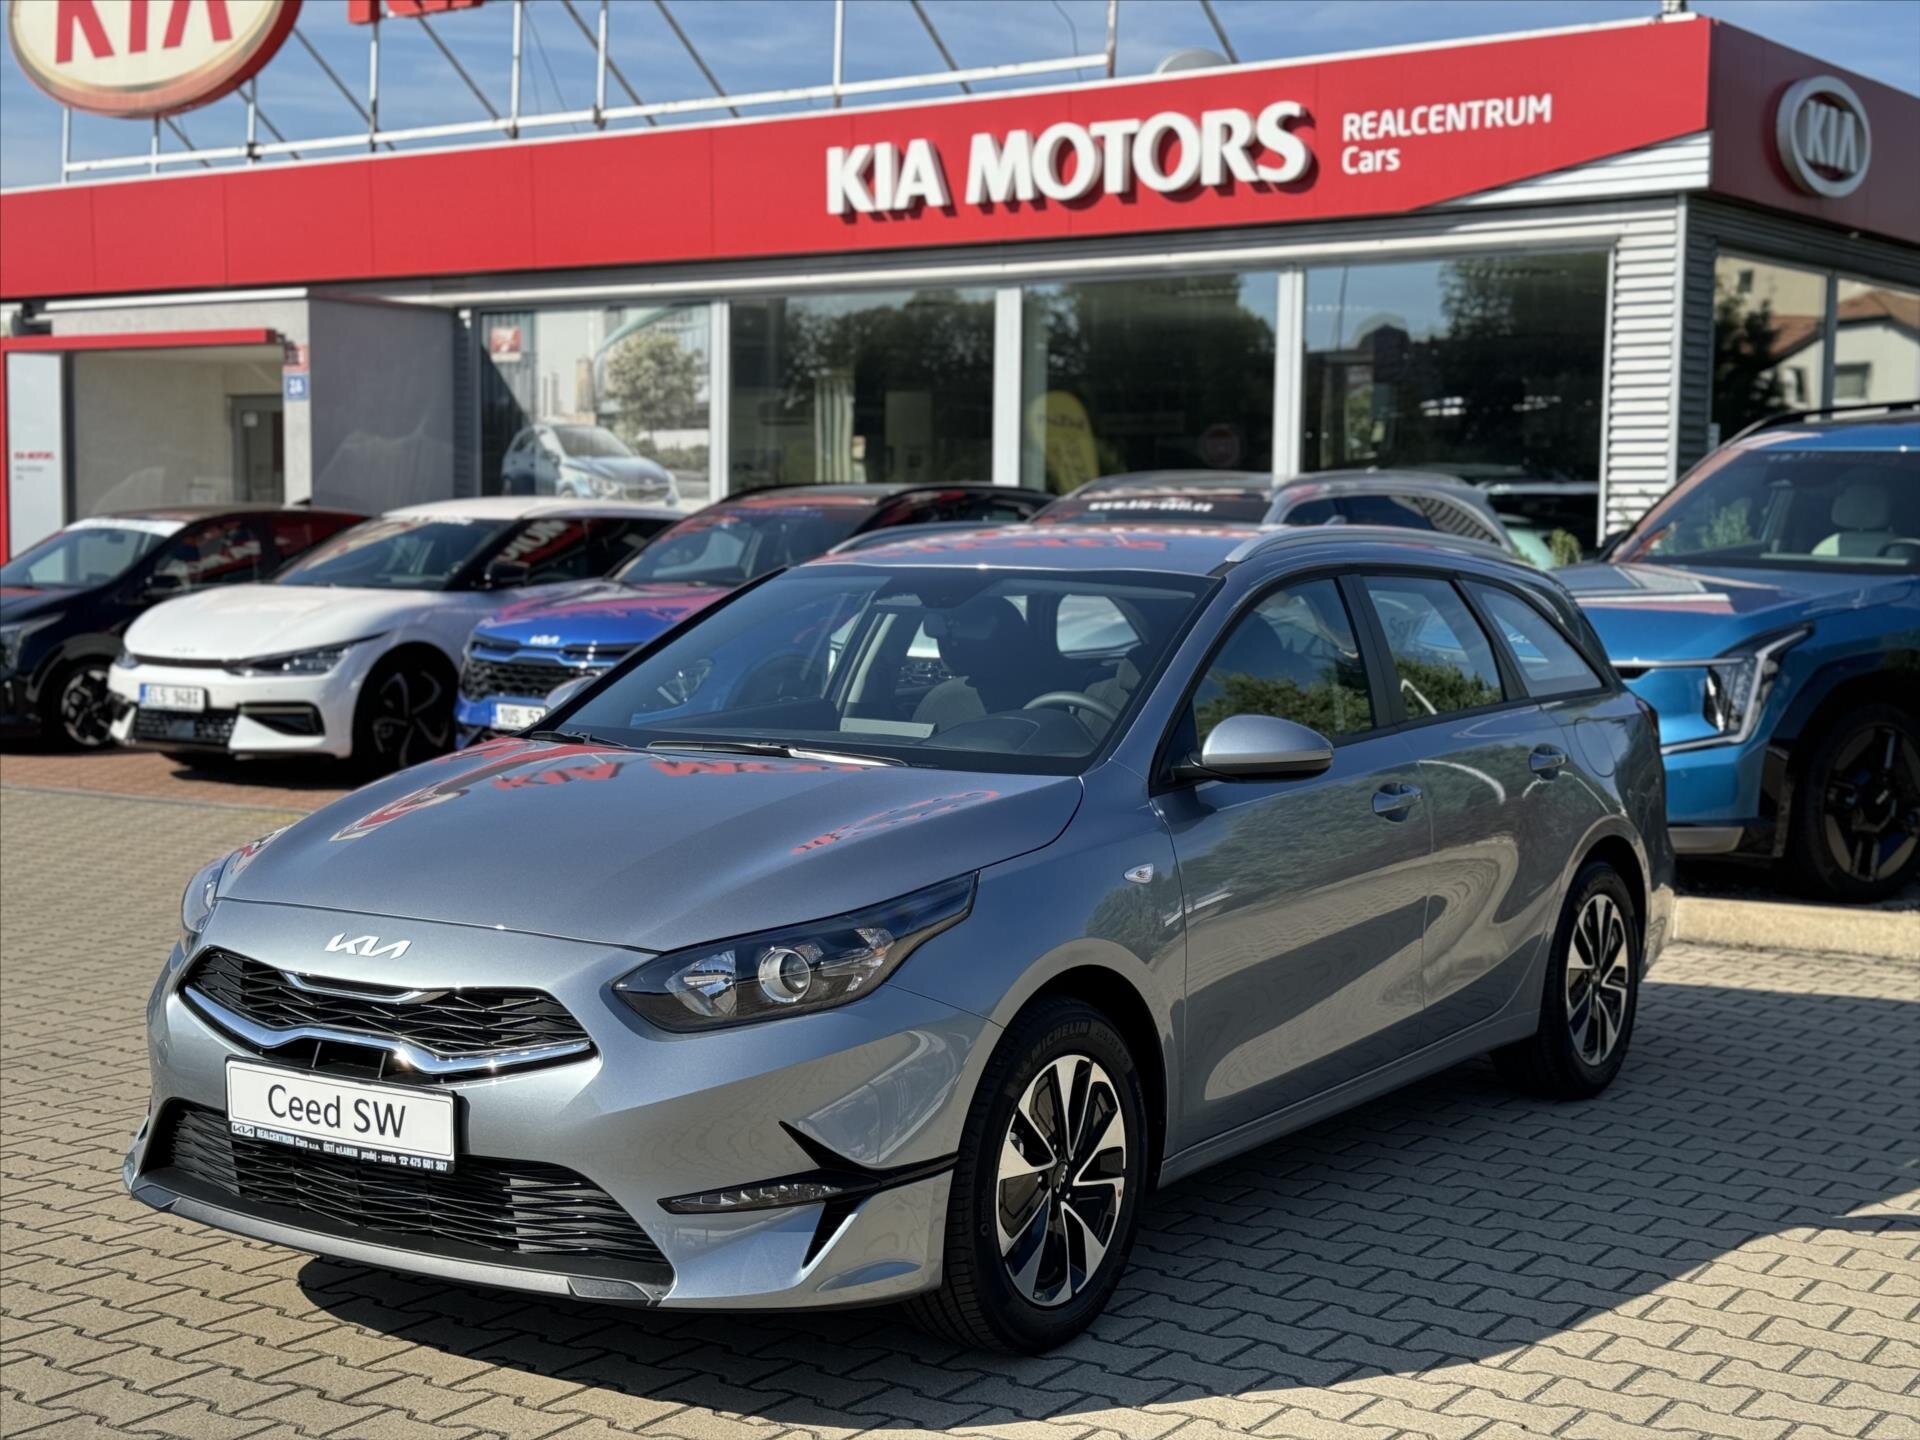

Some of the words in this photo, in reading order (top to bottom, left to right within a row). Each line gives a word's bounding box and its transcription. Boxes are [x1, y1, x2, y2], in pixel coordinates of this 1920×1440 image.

[1342, 93, 1553, 141] REALCENTRUM
[1804, 99, 1858, 172] KIA
[826, 137, 951, 215] KIA
[965, 100, 1312, 206] MOTORS
[1342, 144, 1400, 175] Cars
[324, 932, 412, 960] KIA
[1030, 1022, 1089, 1062] MICHELIN
[268, 1084, 341, 1129] Ceed
[353, 1098, 406, 1138] SW
